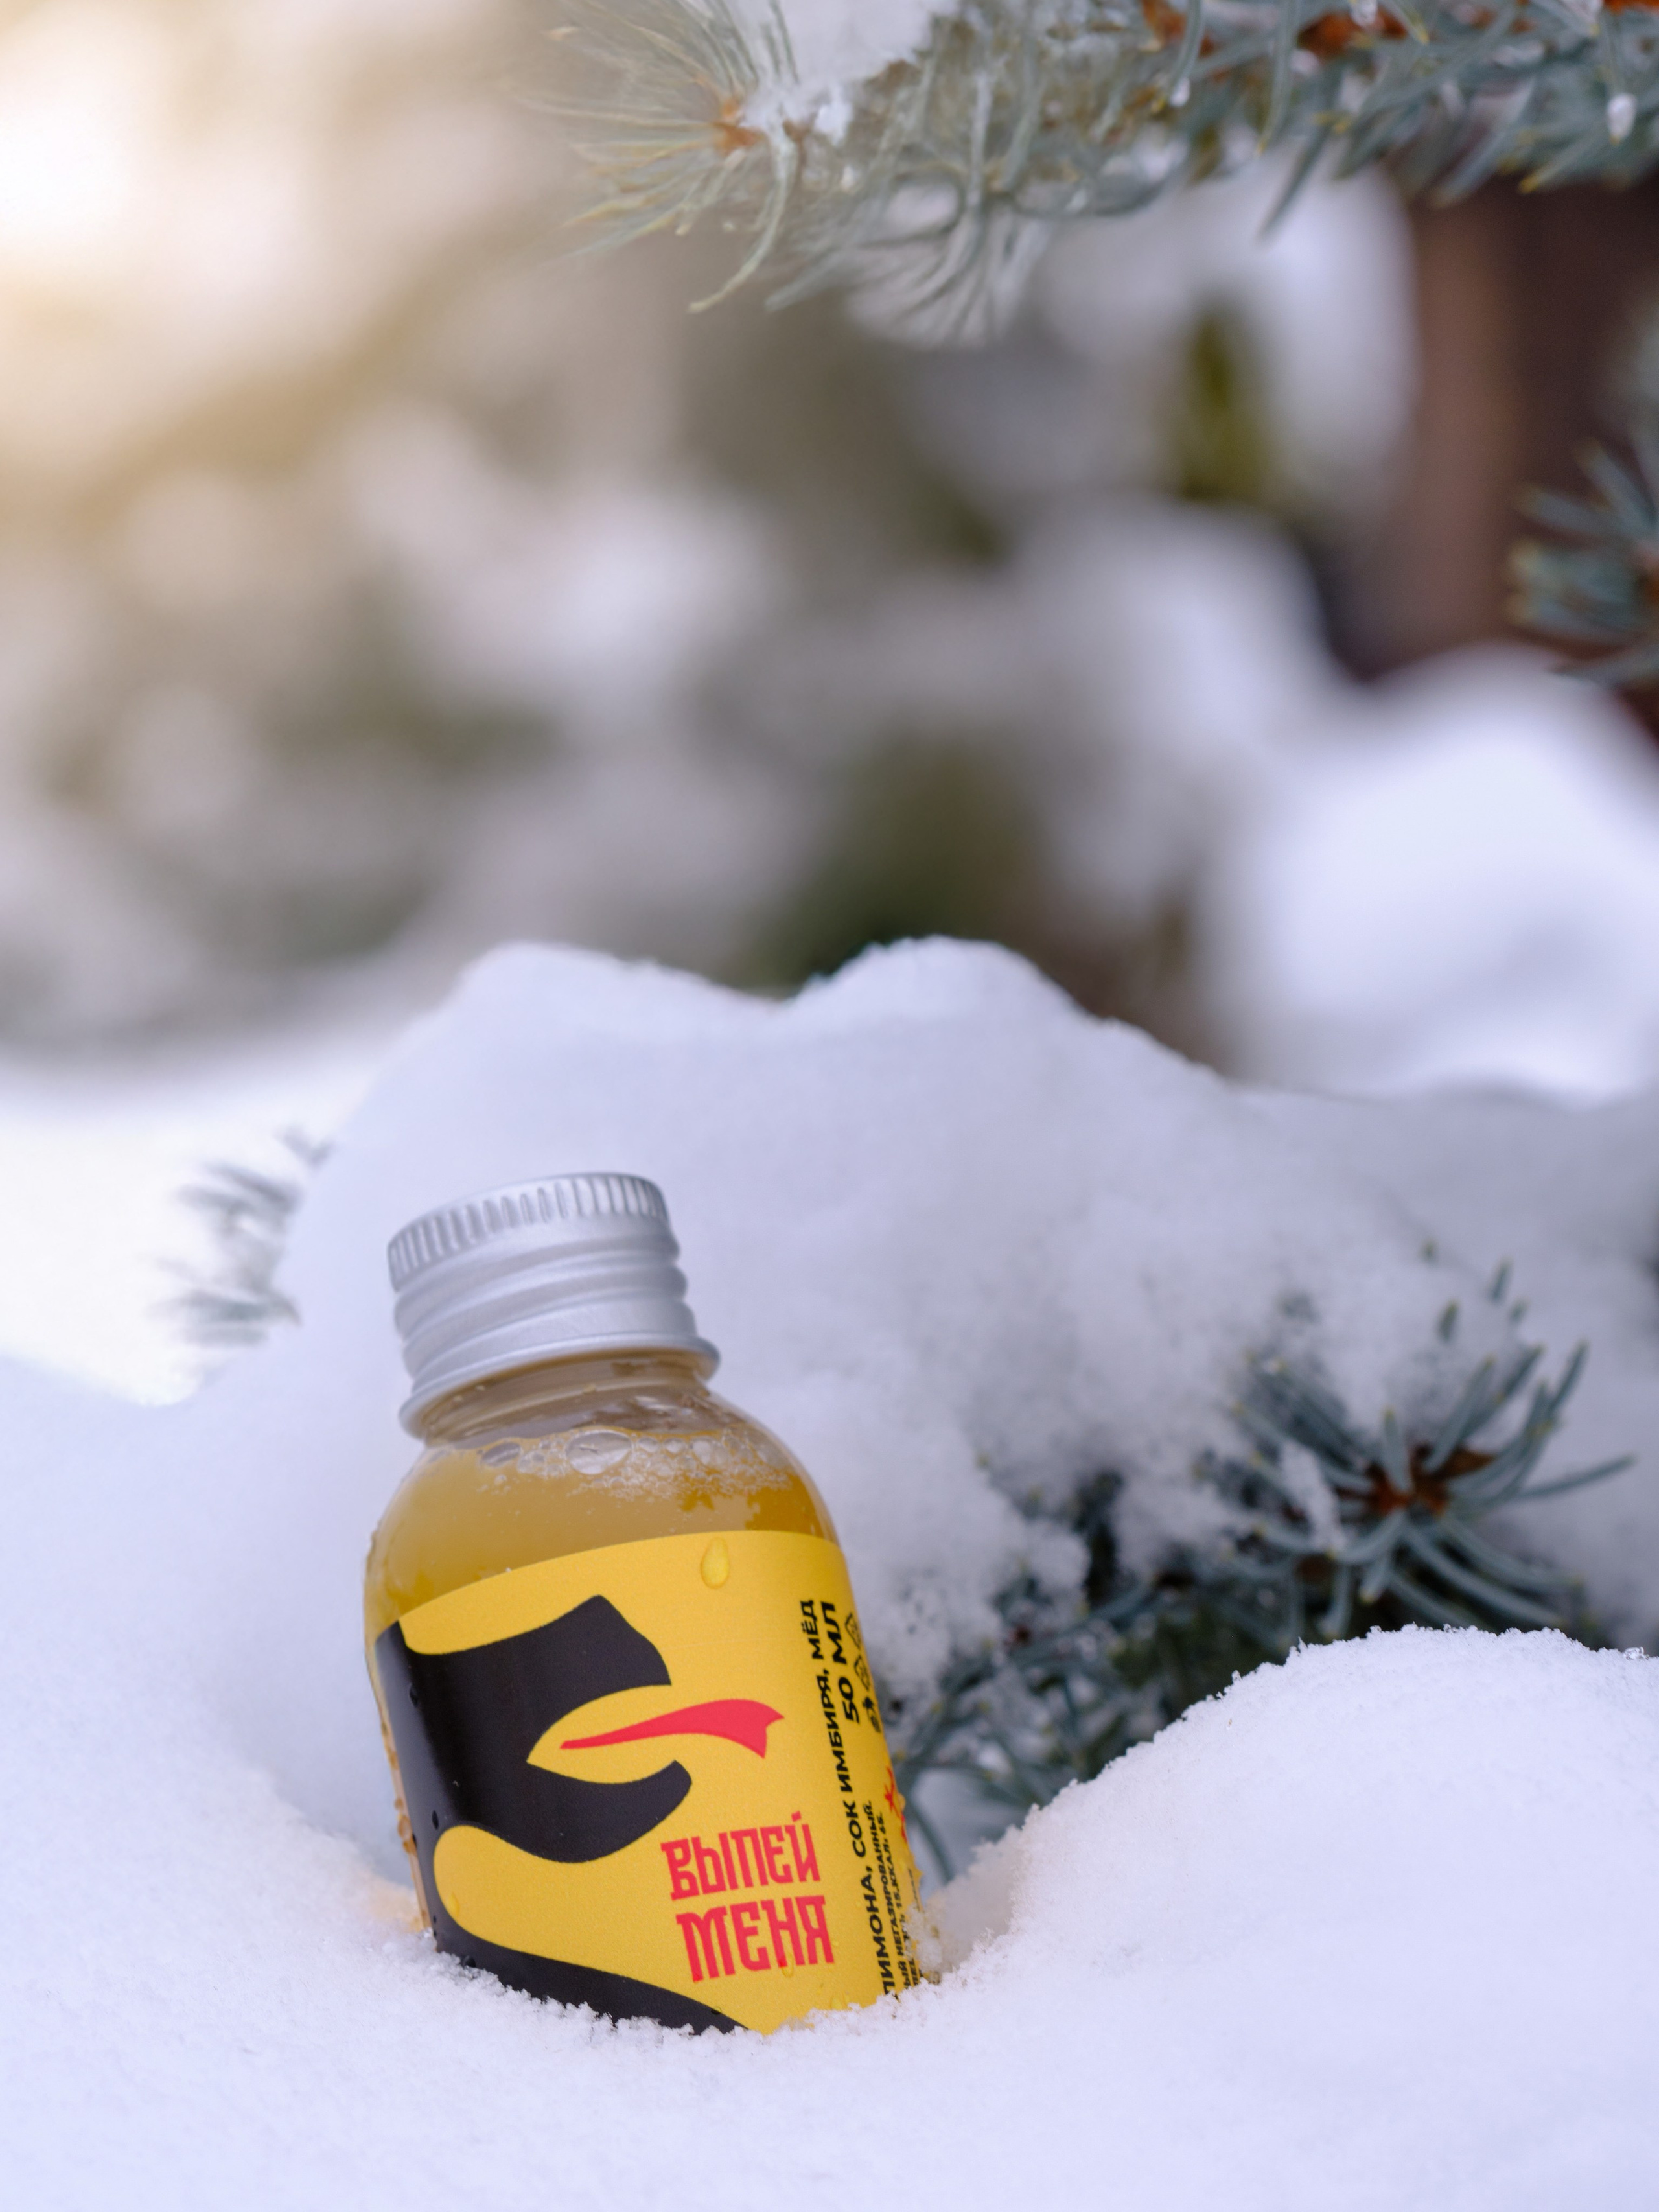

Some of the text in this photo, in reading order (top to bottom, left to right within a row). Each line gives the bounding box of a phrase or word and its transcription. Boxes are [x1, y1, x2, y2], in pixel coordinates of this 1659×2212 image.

[799, 1598, 824, 1660] МЁД
[820, 1600, 861, 1725] 50 МЛ
[815, 1668, 853, 1793] ИМБИРЯ,
[660, 1810, 821, 1902] ВЫПЕЙ
[842, 1800, 866, 1859] СОК
[675, 1894, 835, 1984] МЕНЯ
